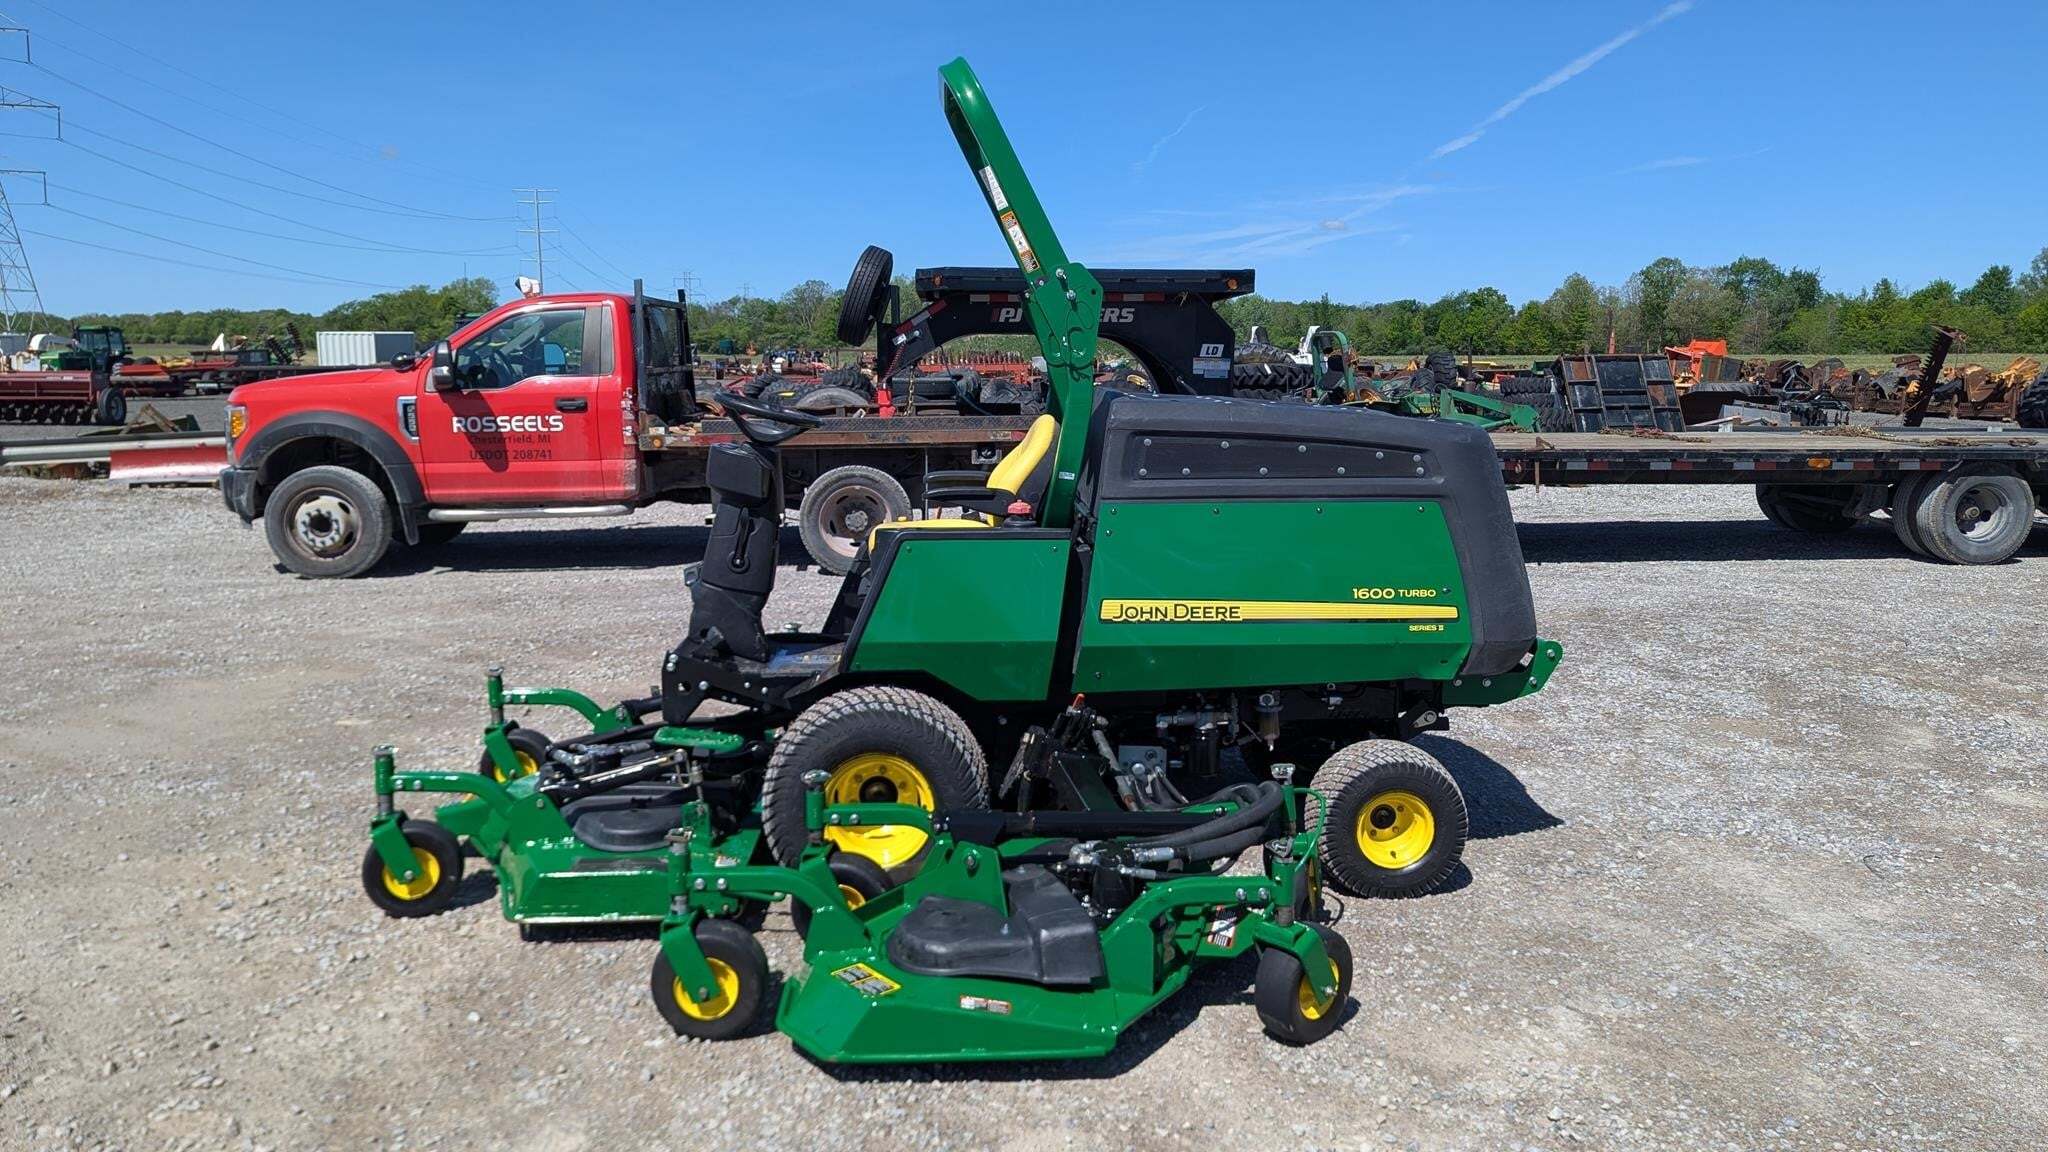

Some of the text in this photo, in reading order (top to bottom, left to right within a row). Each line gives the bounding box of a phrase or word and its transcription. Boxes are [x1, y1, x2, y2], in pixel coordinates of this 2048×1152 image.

[998, 307, 1023, 323] PJ
[1205, 345, 1220, 356] LD
[451, 415, 564, 433] ROSSEEL'S
[537, 434, 551, 443] MI
[512, 449, 553, 460] 208741
[1352, 588, 1437, 599] 1600 TURBO
[1112, 603, 1241, 619] JOHN DEERE
[1408, 624, 1437, 632] SERIES
